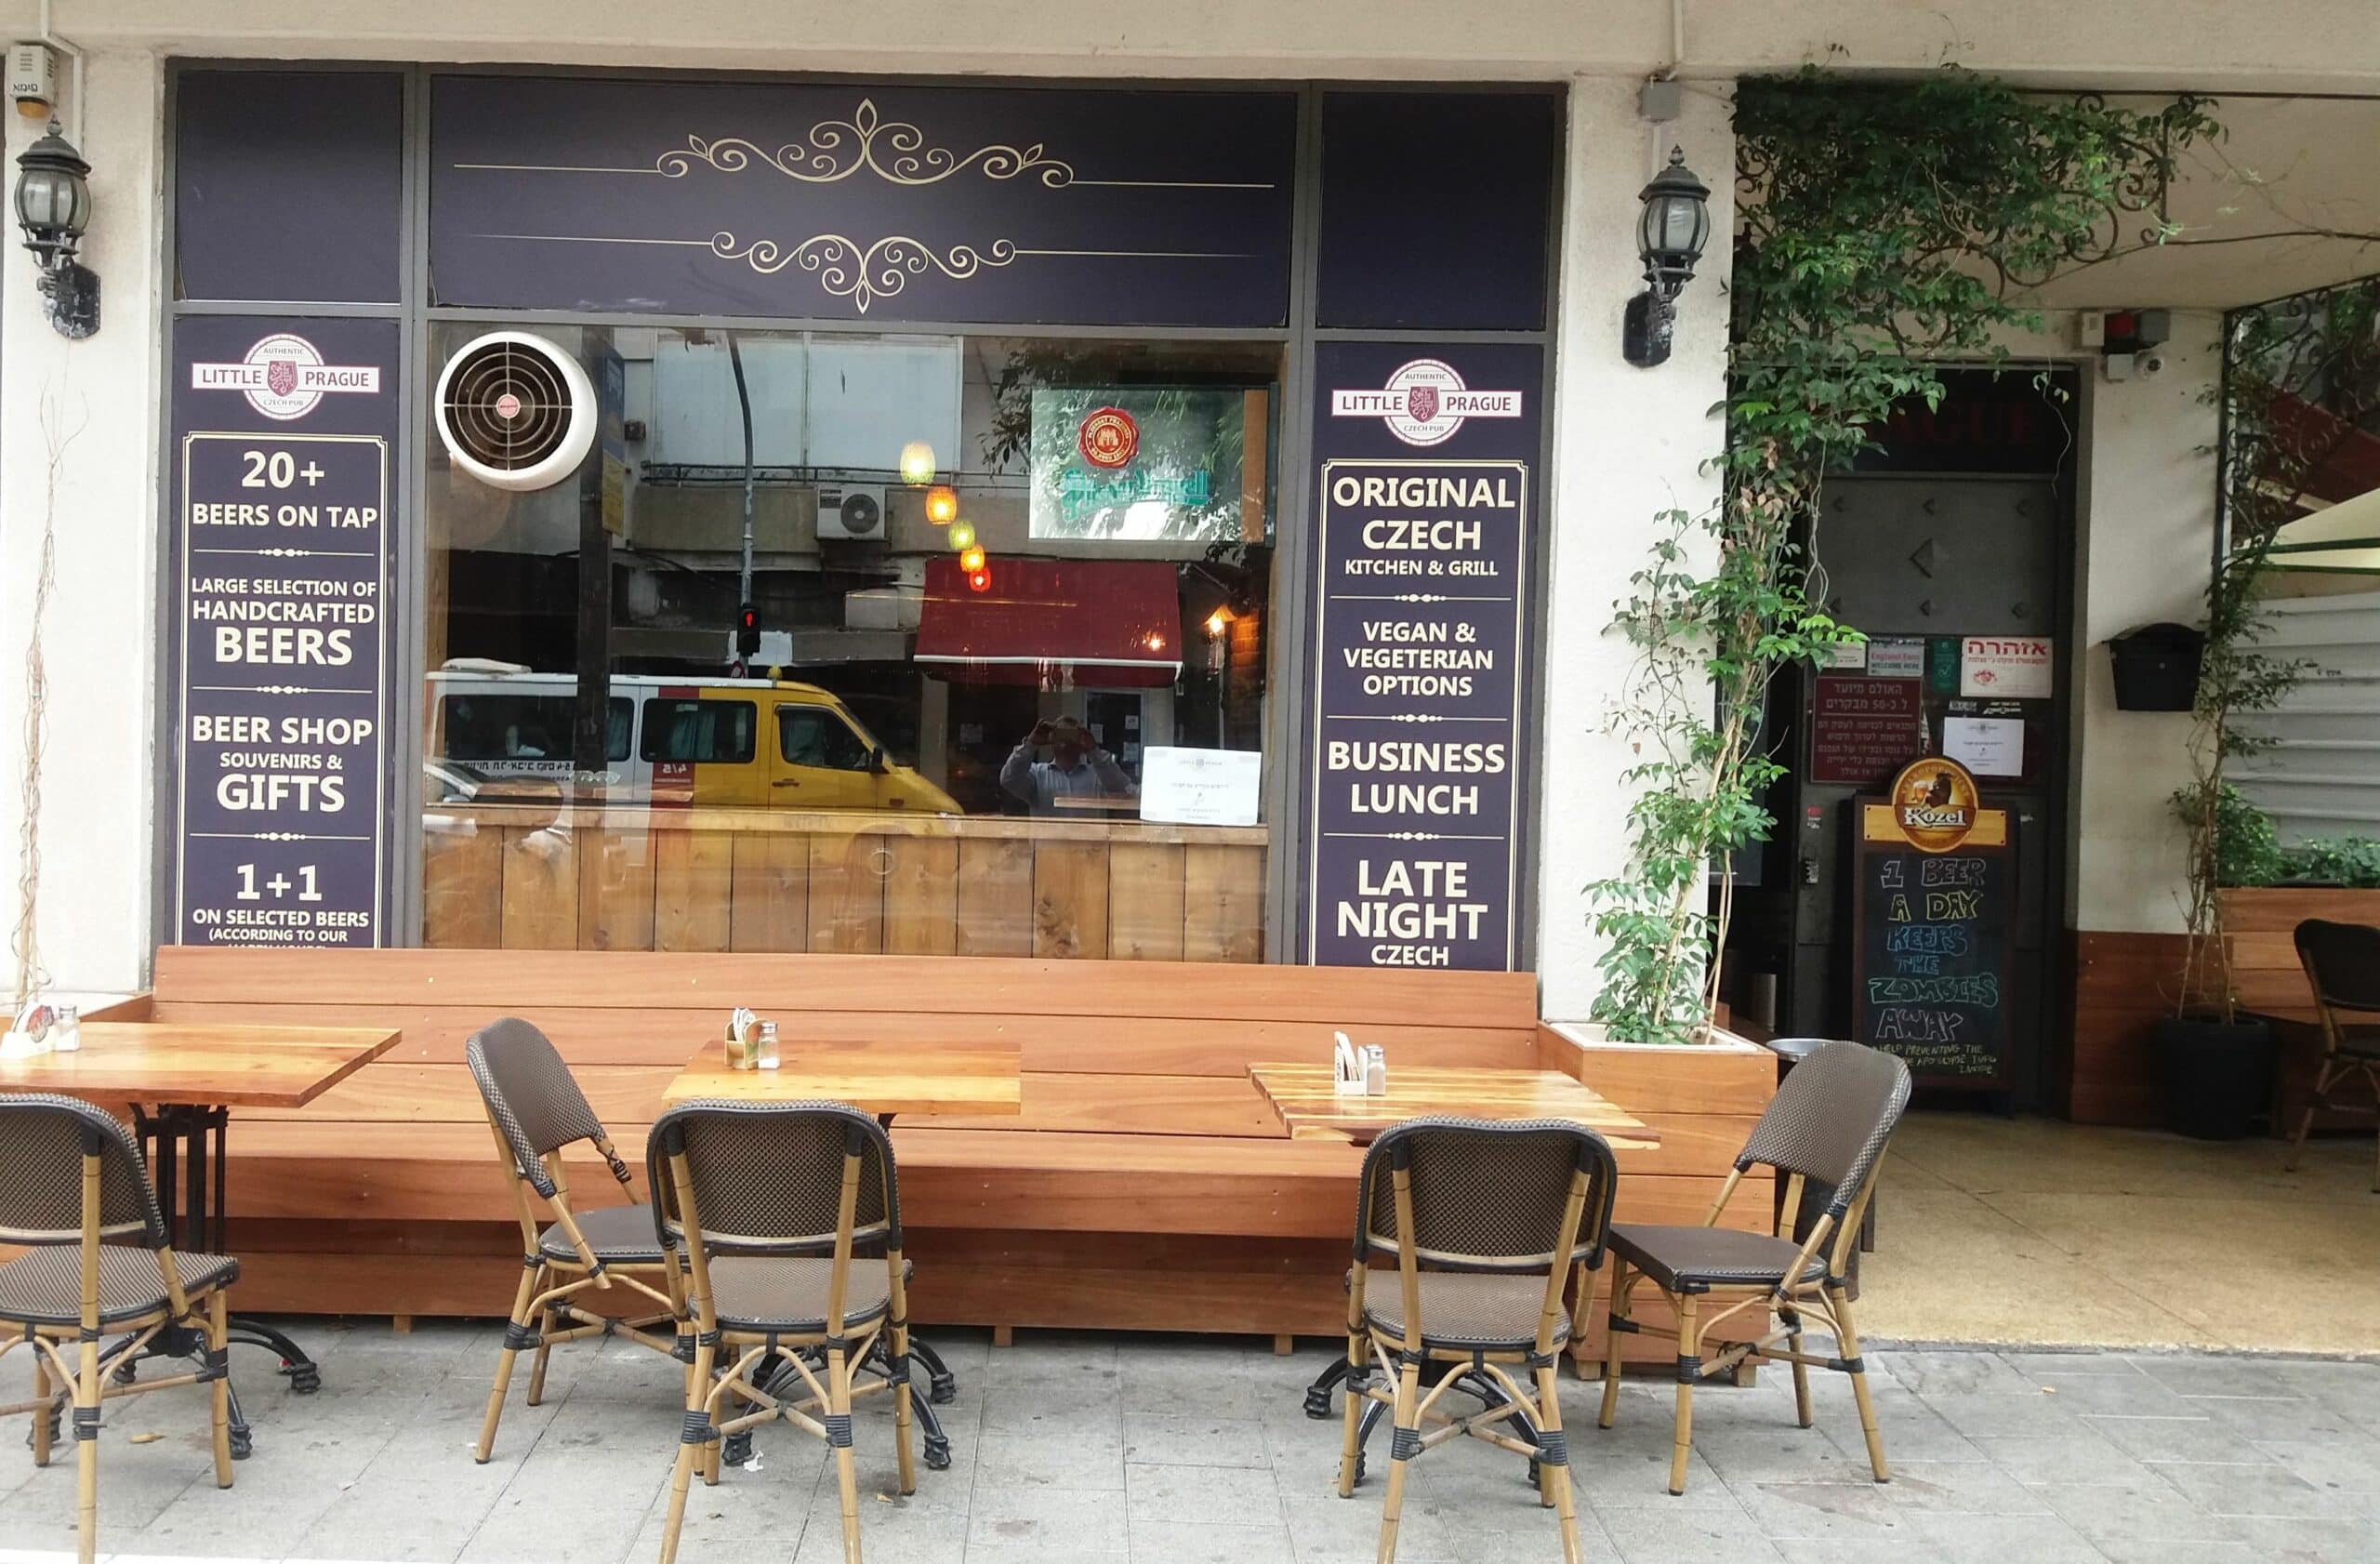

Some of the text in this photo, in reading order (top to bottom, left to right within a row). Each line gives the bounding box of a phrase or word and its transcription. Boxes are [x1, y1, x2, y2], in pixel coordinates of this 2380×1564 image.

[263, 347, 304, 355] AUTHENTIC
[202, 368, 369, 387] LITTLE PRAGUE
[1342, 395, 1512, 411] LITTLE PRAGUE
[242, 450, 325, 489] 20+
[1333, 476, 1515, 508] ORIGINAL
[192, 503, 378, 529] BEERS ON TAP
[1362, 520, 1481, 550] CZECH
[1345, 559, 1499, 577] KITCHEN & GRILL
[192, 577, 377, 597] LARGE SELECTION OF
[192, 600, 375, 624] HANDCRAFTED
[1362, 621, 1476, 643] VEGAN &
[215, 626, 352, 666] BEERS
[1343, 647, 1493, 669] VEGETERIAN
[1968, 641, 2047, 656] אזהרה
[1363, 674, 1473, 696] OPTIONS
[192, 715, 373, 745] BEER SHOP
[219, 751, 343, 770] SOUVENIRS &
[1328, 741, 1505, 774] BUSINESS
[217, 773, 345, 813] GIFTS
[1351, 783, 1478, 815] LUNCH
[1904, 806, 1966, 828] Kozel
[237, 863, 323, 901] 1+1
[1358, 859, 1468, 898] LATE
[1881, 857, 1987, 889] 1 BEER
[192, 908, 369, 928] ON SELECTED BEERS
[1888, 890, 1984, 922] A DAY
[1337, 901, 1488, 940] NIGHT
[209, 928, 348, 942] (ACCORDING TO OUR
[1886, 923, 1968, 956] KEEPS
[1370, 944, 1449, 966] CZECH
[1897, 956, 1940, 974] THE
[1868, 972, 1999, 1008] ZOMBIES
[1875, 1008, 1964, 1042] AWAY
[1965, 1044, 1983, 1054] THE
